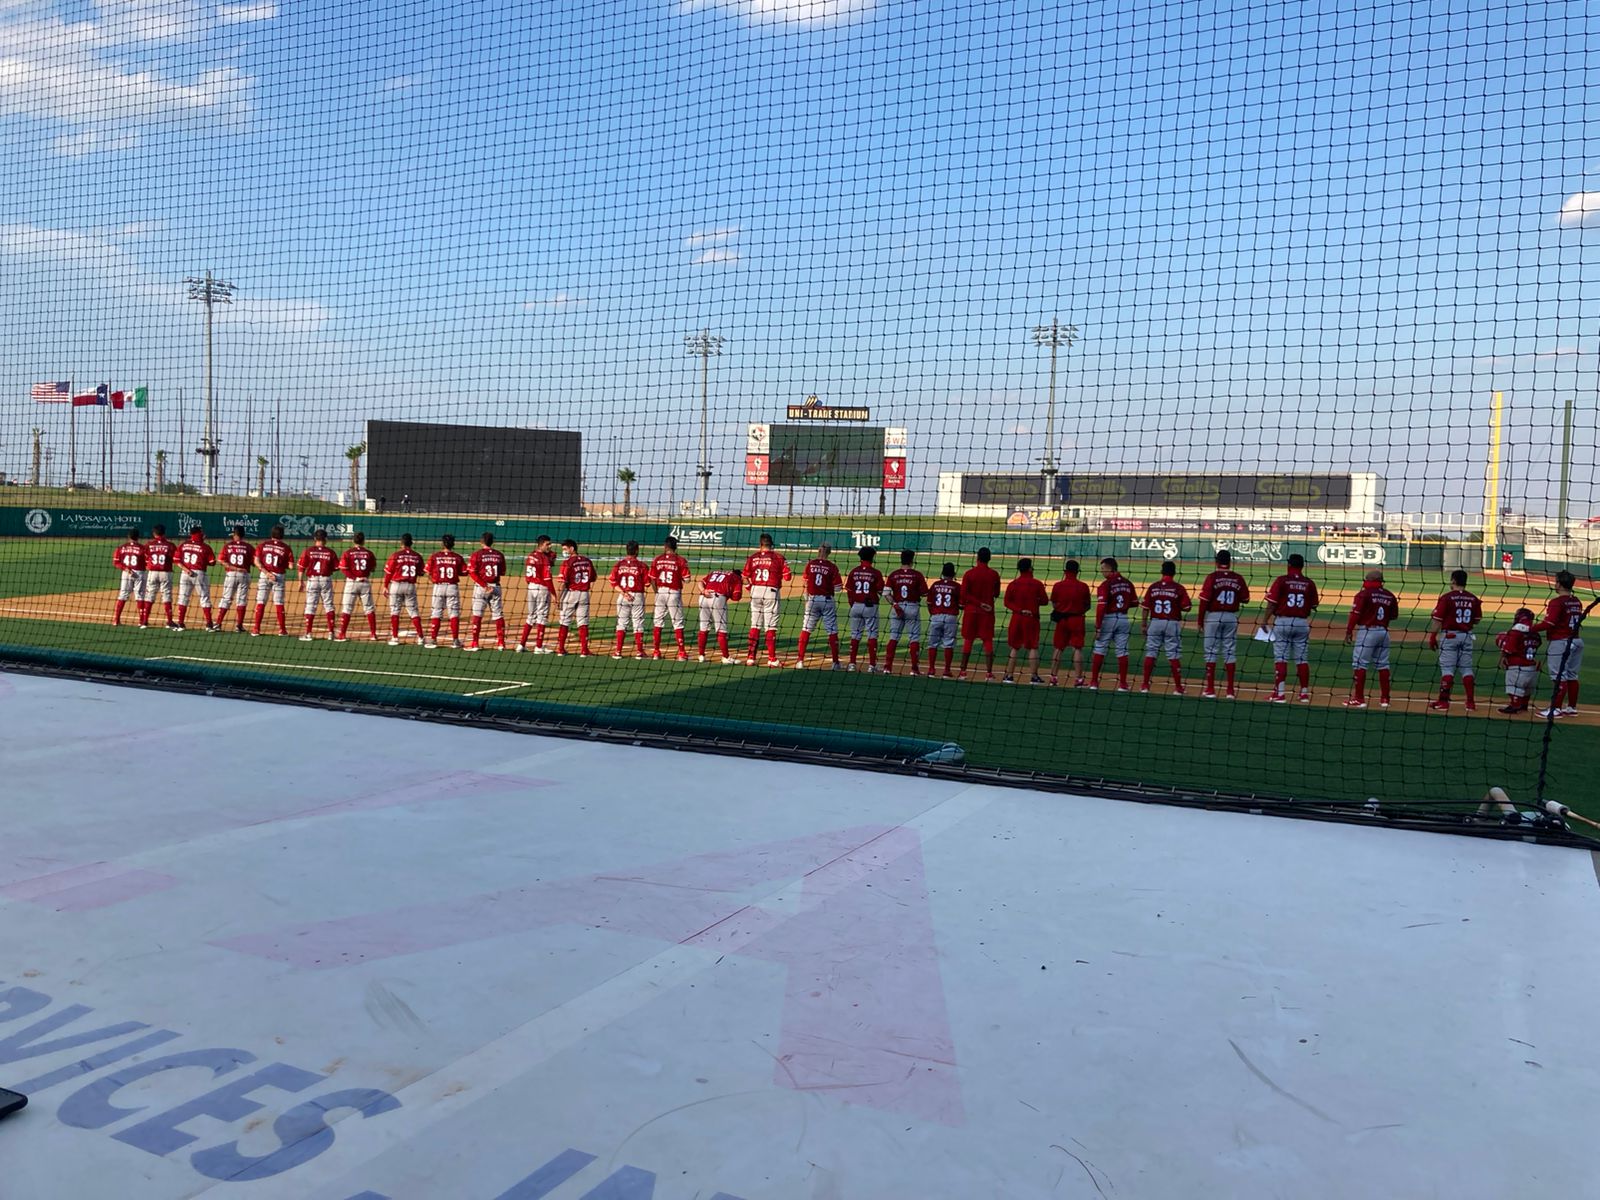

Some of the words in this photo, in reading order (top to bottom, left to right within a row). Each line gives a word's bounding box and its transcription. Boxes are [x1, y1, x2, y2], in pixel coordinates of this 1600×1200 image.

[788, 408, 833, 418] UNI-TRADE
[834, 410, 869, 420] STADIUM
[61, 514, 74, 523] LA
[75, 514, 113, 524] POSADA
[114, 516, 143, 524] HOTEL
[680, 530, 723, 540] LSMC
[123, 555, 138, 566] 48
[230, 554, 244, 566] 69
[265, 553, 279, 567] 61
[354, 559, 367, 571] 13
[313, 561, 322, 573] 4
[485, 565, 499, 577] 31
[658, 571, 674, 584] 45
[901, 585, 908, 599] 6
[935, 593, 952, 607] 33
[1286, 593, 1305, 608] 35
